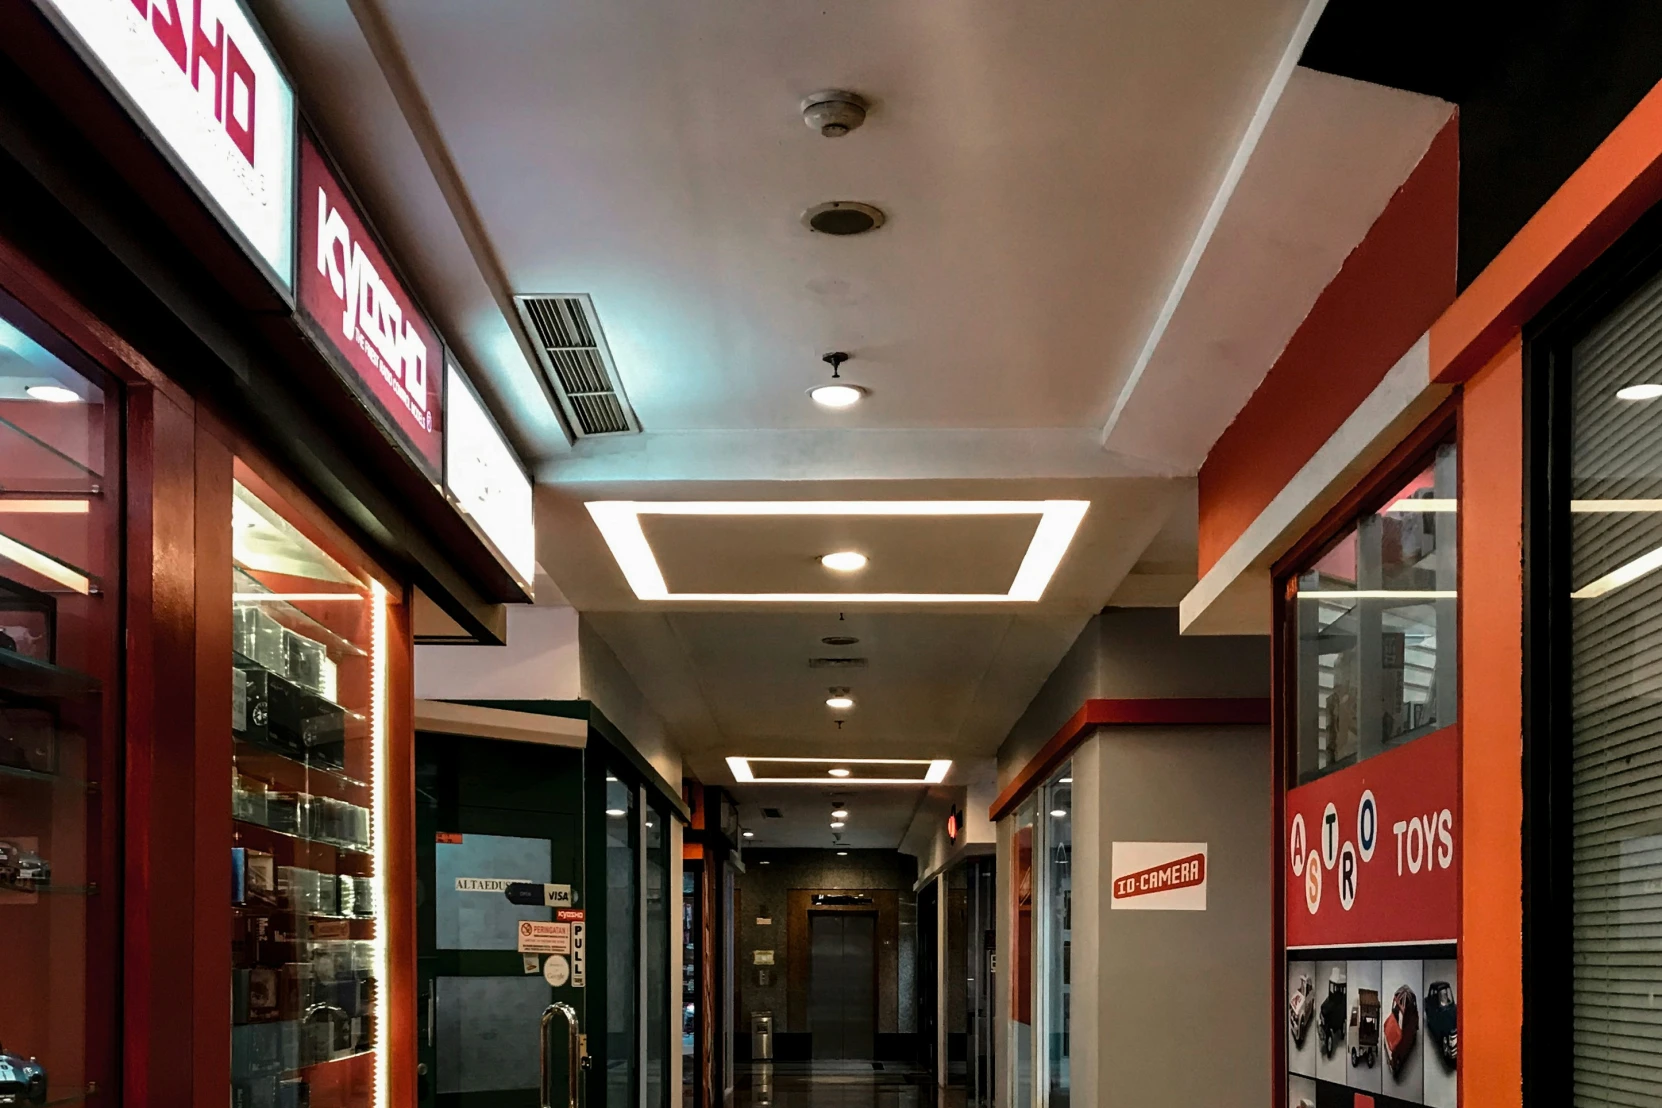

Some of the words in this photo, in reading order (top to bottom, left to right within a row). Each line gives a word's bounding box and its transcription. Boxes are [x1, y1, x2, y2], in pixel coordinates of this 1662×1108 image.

[131, 0, 256, 169] SHO
[1293, 799, 1375, 904] ASTRO
[1393, 808, 1453, 877] TOYS
[548, 891, 569, 902] VISA
[574, 925, 582, 975] PULL
